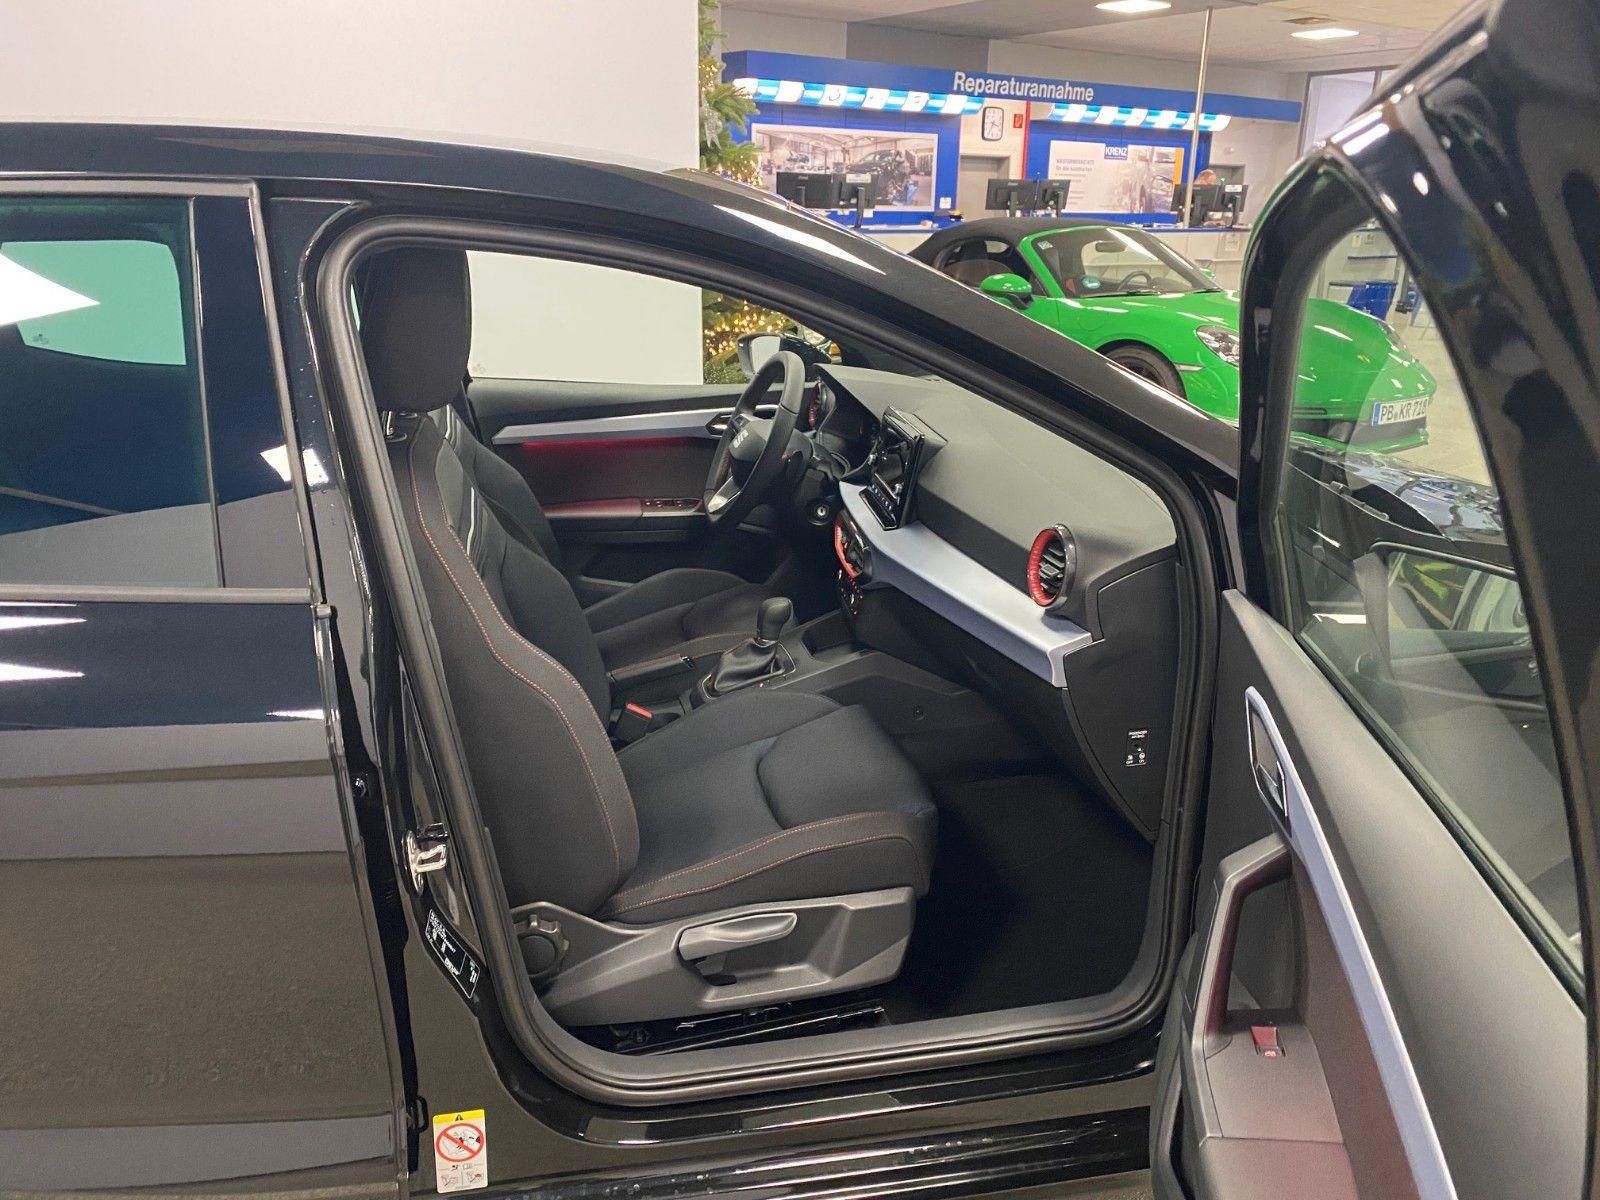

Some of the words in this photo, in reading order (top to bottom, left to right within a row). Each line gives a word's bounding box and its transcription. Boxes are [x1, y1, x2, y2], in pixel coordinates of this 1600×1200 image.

[953, 71, 1094, 102] Reparaturannahme
[1105, 146, 1128, 156] KRENZ
[1380, 405, 1394, 422] PB
[1398, 402, 1412, 420] KR
